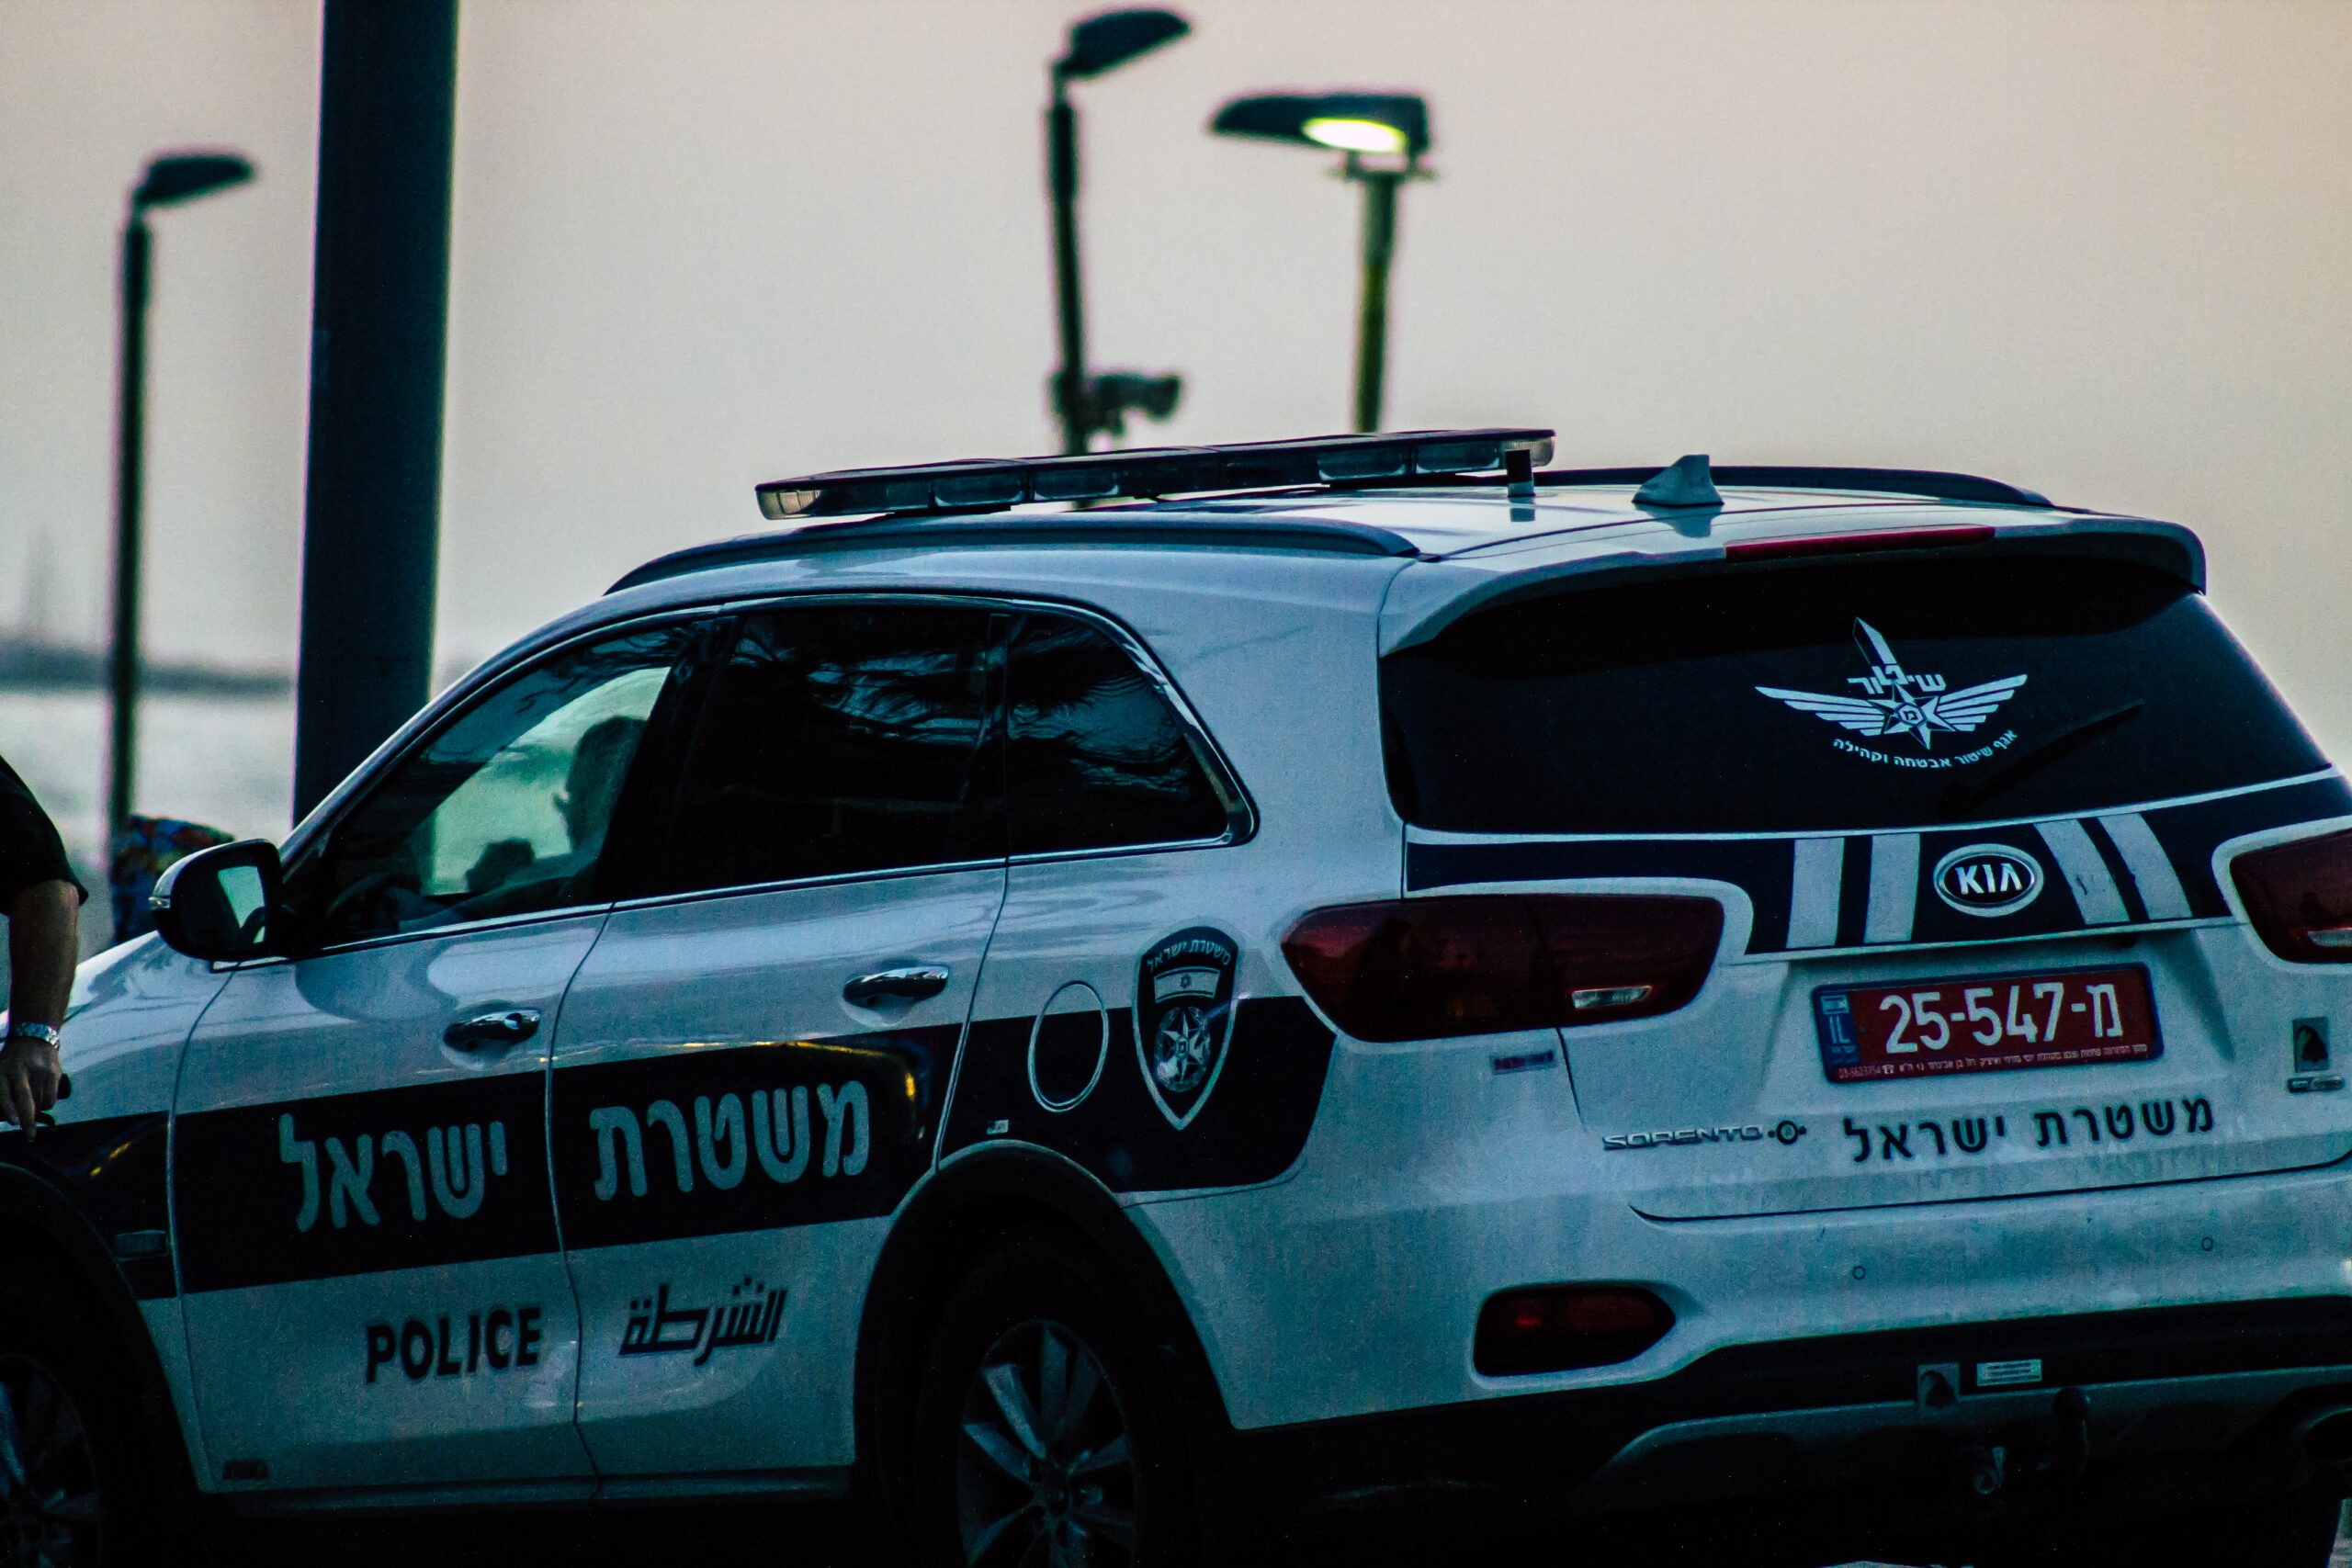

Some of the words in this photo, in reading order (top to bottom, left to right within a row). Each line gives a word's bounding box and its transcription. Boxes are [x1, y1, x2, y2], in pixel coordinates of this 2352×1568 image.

[1847, 664, 1947, 694] שיטור
[1832, 738, 1889, 764] וקהילה
[1953, 745, 1994, 766] שיטור
[1993, 729, 2018, 750] אגף
[1894, 755, 1952, 769] אבטחה
[1955, 862, 2023, 896] KIA
[1602, 1124, 1763, 1150] SORENTO
[1843, 1115, 2006, 1163] ישראל
[2033, 1097, 2214, 1147] משטרת
[588, 1080, 870, 1201] משטרת
[279, 1112, 509, 1233] ישראל
[619, 1277, 786, 1367] الشرطة
[368, 1306, 542, 1383] POLICE
